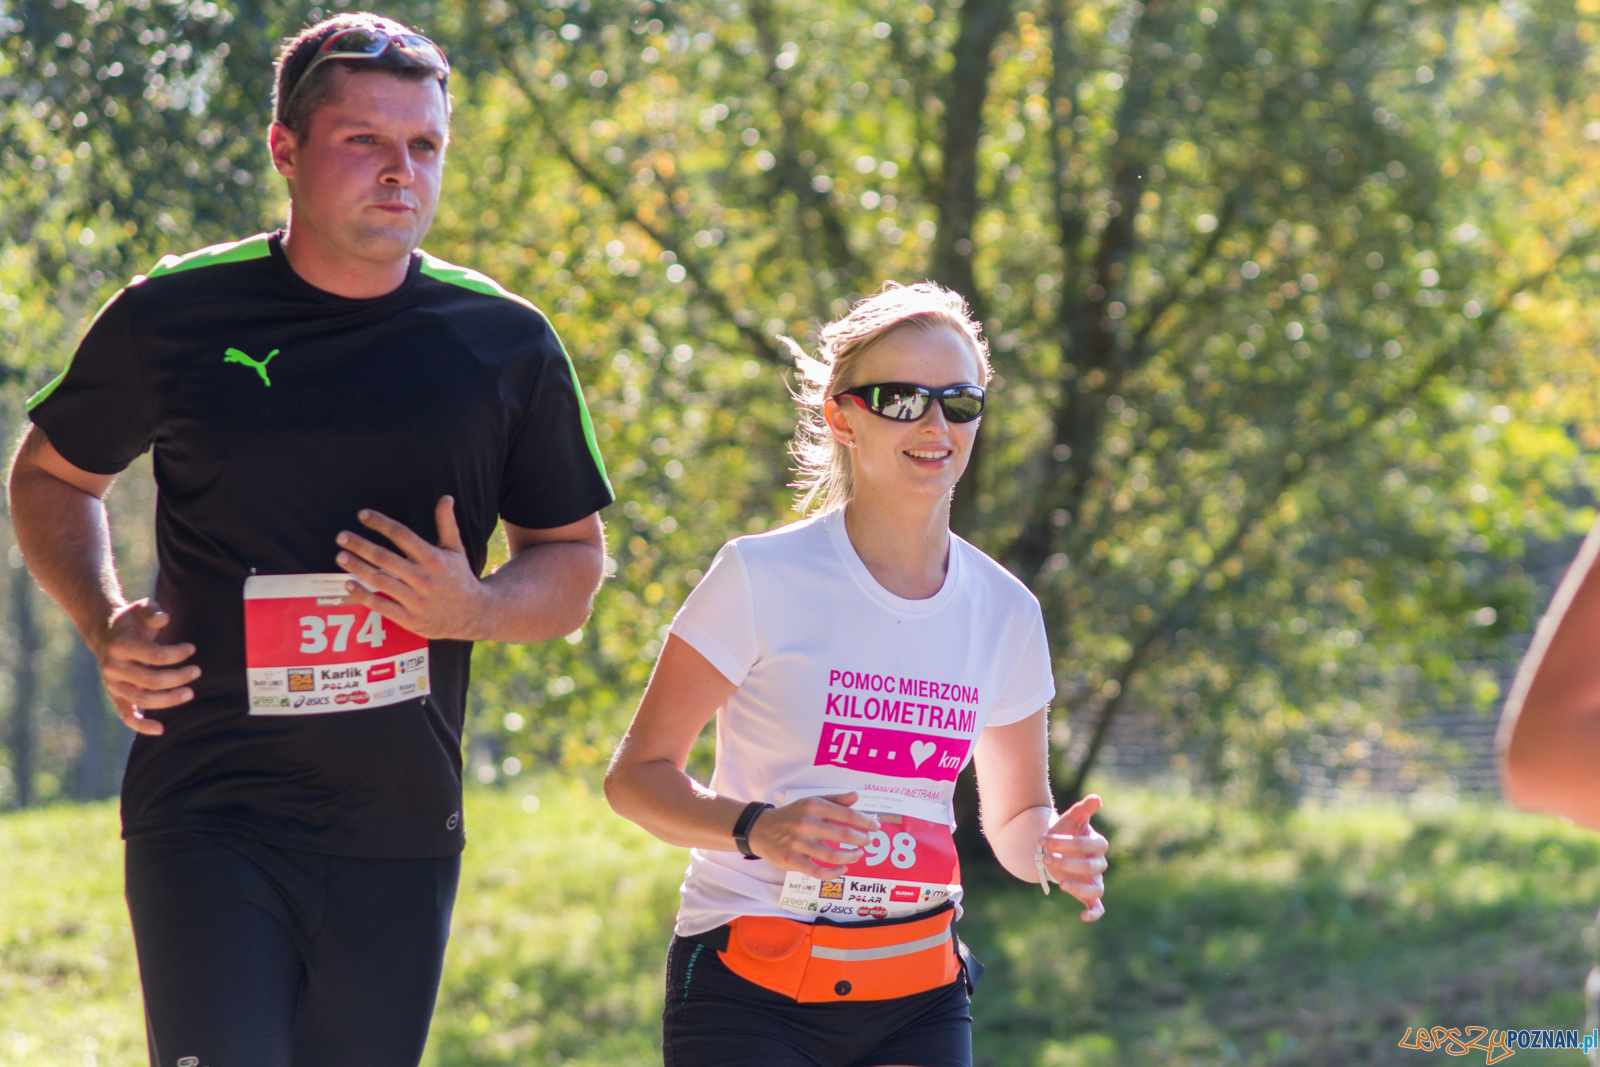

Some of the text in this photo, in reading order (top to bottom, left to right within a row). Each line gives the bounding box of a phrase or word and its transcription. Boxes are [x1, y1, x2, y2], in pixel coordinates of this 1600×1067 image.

[299, 610, 386, 654] 374
[289, 674, 313, 684] 24
[321, 667, 362, 680] Karlik
[321, 681, 359, 691] POLAR
[829, 669, 979, 705] POMOC MIERZONA
[253, 696, 279, 707] green
[825, 692, 977, 733] KILOMETRAMI
[938, 750, 961, 769] km
[839, 830, 917, 870] 98
[821, 881, 843, 893] 24
[850, 881, 886, 894] Karlik
[820, 891, 842, 899] SEVEN
[848, 894, 882, 904] POLAR
[781, 896, 809, 907] green
